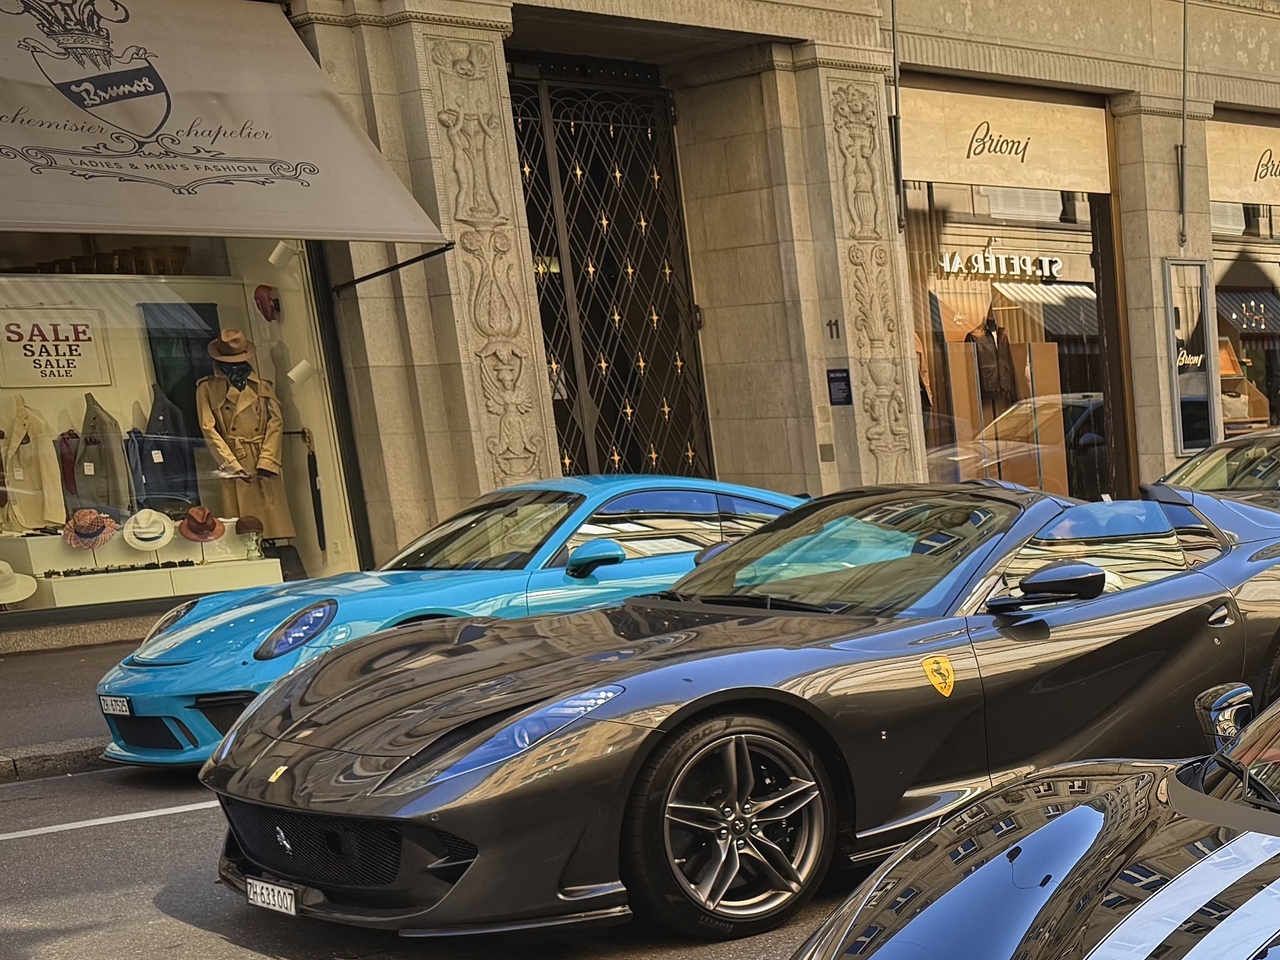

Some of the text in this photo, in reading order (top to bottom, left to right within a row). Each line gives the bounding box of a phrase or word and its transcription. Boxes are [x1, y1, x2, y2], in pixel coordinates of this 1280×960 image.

[0, 106, 273, 145] chemisier chapelier
[69, 158, 258, 173] LADIES & MEN'S FASHION
[5, 323, 92, 342] SALE
[826, 319, 840, 339] 11
[23, 344, 82, 357] SALE
[33, 359, 76, 369] SALE
[40, 370, 73, 378] SALE
